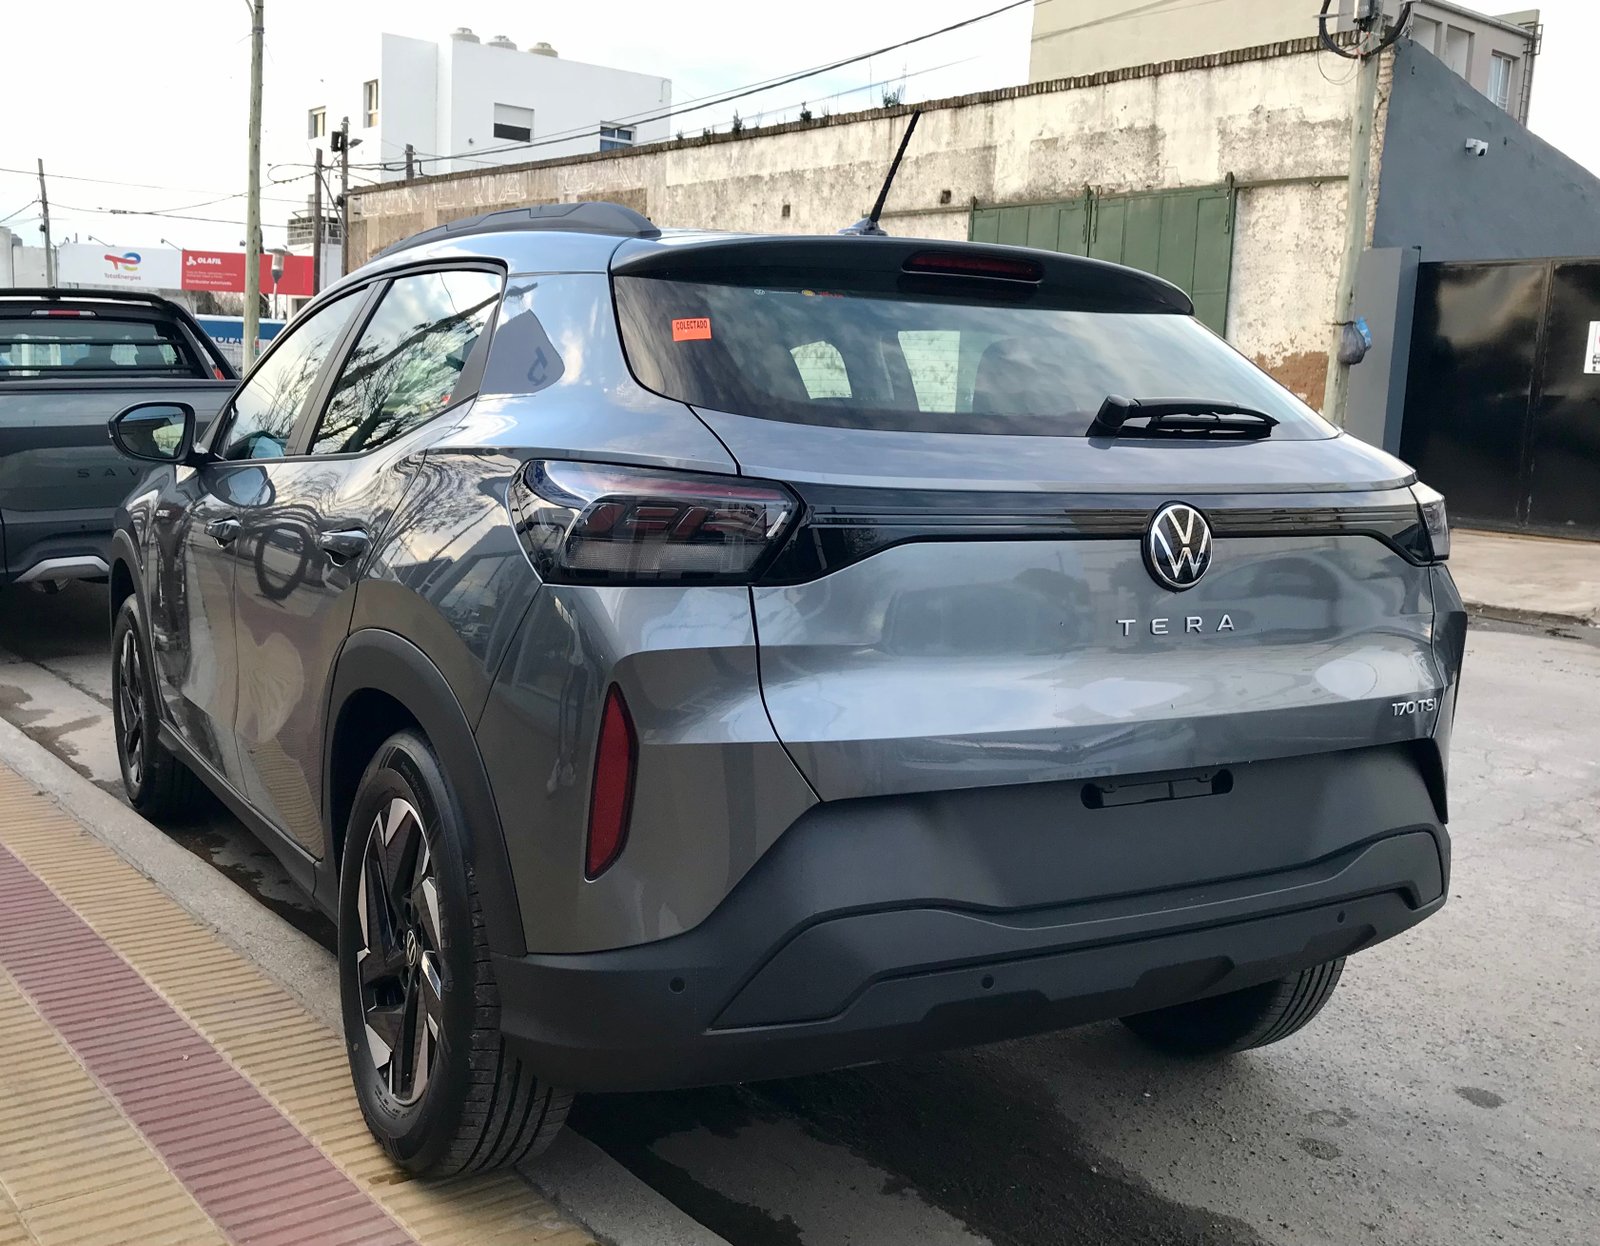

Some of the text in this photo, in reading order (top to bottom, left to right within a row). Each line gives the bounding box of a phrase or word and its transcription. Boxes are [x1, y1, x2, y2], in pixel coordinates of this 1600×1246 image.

[104, 273, 141, 281] TotalEnergies
[675, 320, 708, 330] COLECTADO
[1116, 614, 1235, 636] TERA
[1391, 697, 1437, 716] 170 TSI
